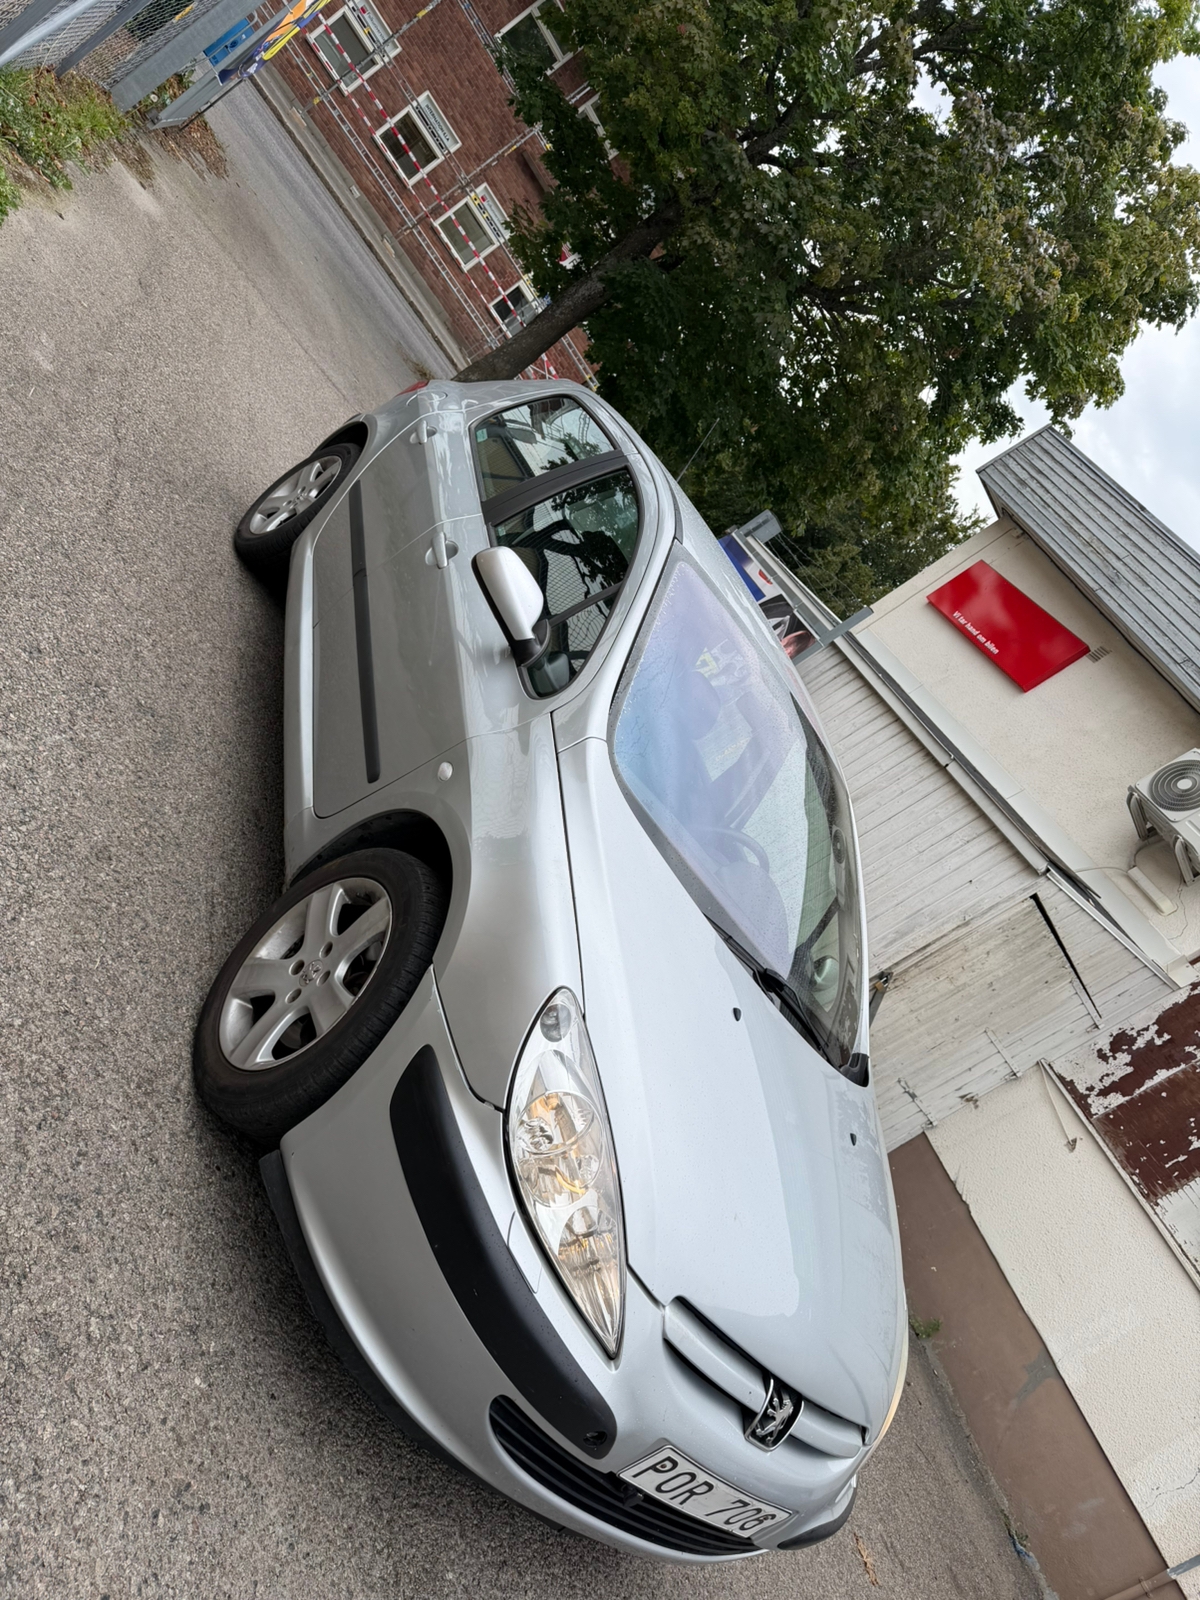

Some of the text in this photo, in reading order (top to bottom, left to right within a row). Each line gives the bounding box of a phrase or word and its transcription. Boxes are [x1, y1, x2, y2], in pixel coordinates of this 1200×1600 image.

[953, 610, 999, 654] Vi tar hand om bilen
[631, 1455, 777, 1531] POR 706
